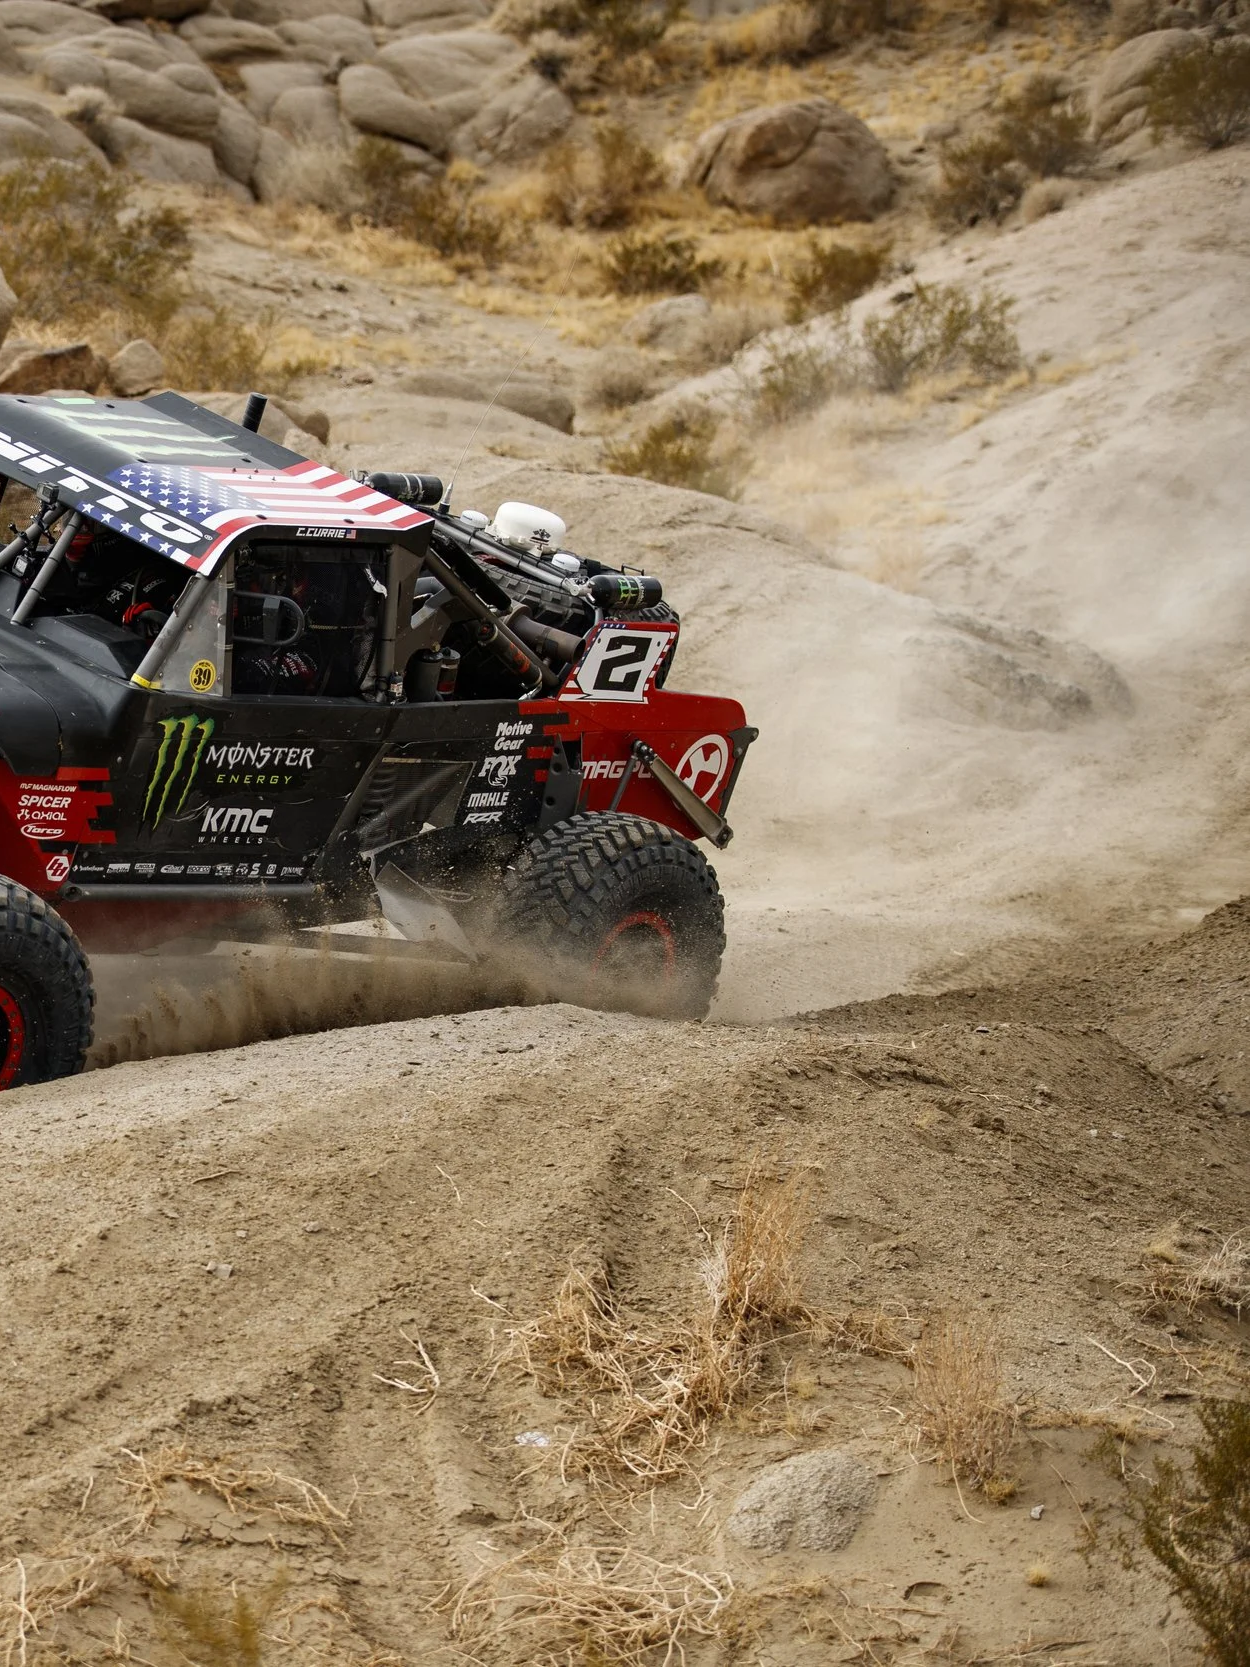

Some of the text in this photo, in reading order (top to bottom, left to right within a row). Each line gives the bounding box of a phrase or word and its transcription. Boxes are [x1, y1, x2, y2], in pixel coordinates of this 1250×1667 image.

[295, 527, 346, 539] C.CURRIE
[592, 634, 653, 693] 2
[193, 667, 212, 687] 39
[495, 720, 534, 737] Motive
[493, 736, 524, 751] Gear
[205, 741, 315, 770] MONSTER
[478, 754, 522, 780] FOX
[216, 774, 293, 785] ENERGY
[32, 783, 78, 793] MAGNAFLOW
[18, 794, 72, 809] SPICER
[467, 791, 510, 808] MAHLE
[200, 807, 274, 834] KMC
[26, 825, 63, 835] Torco
[198, 836, 263, 844] WHEELS
